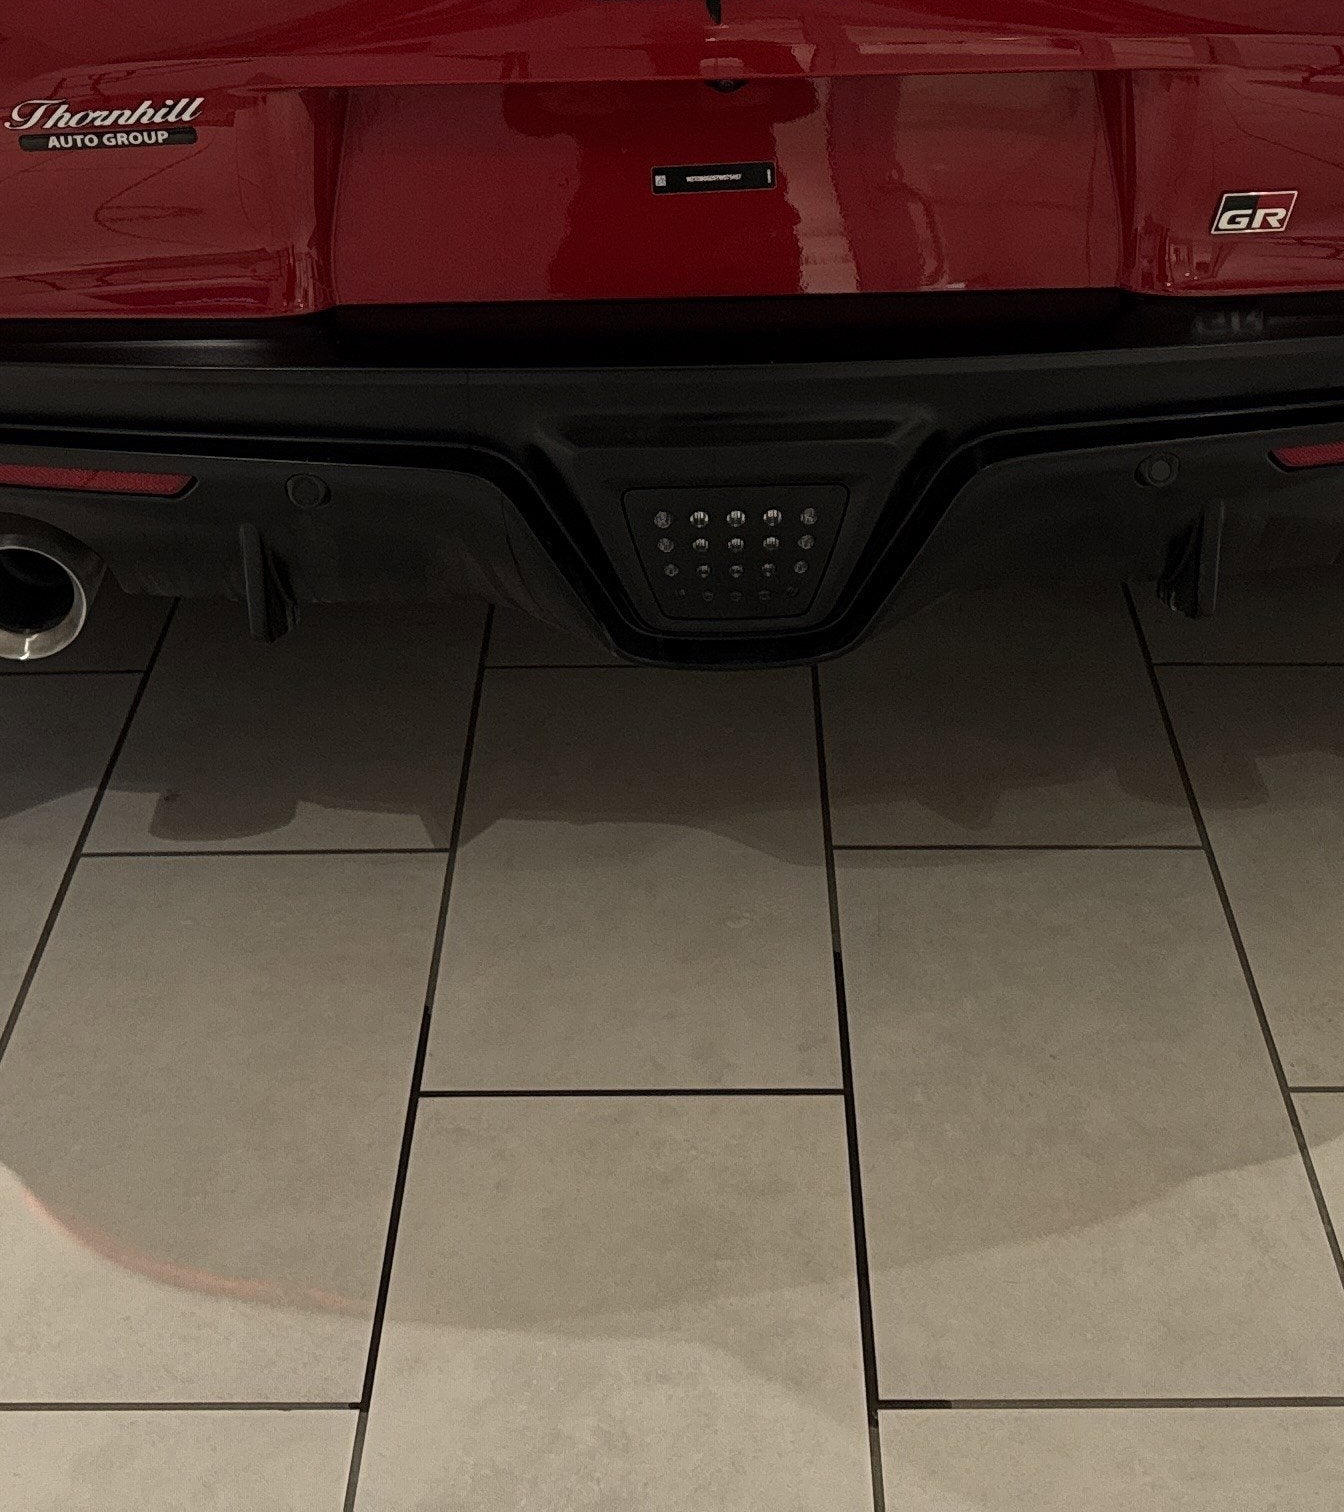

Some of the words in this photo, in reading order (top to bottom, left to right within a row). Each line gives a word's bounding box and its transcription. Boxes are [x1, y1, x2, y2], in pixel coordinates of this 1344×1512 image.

[4, 96, 205, 130] Thornhill
[47, 134, 98, 149] AUTO
[102, 130, 169, 146] GROUP
[1217, 207, 1287, 230] GR
